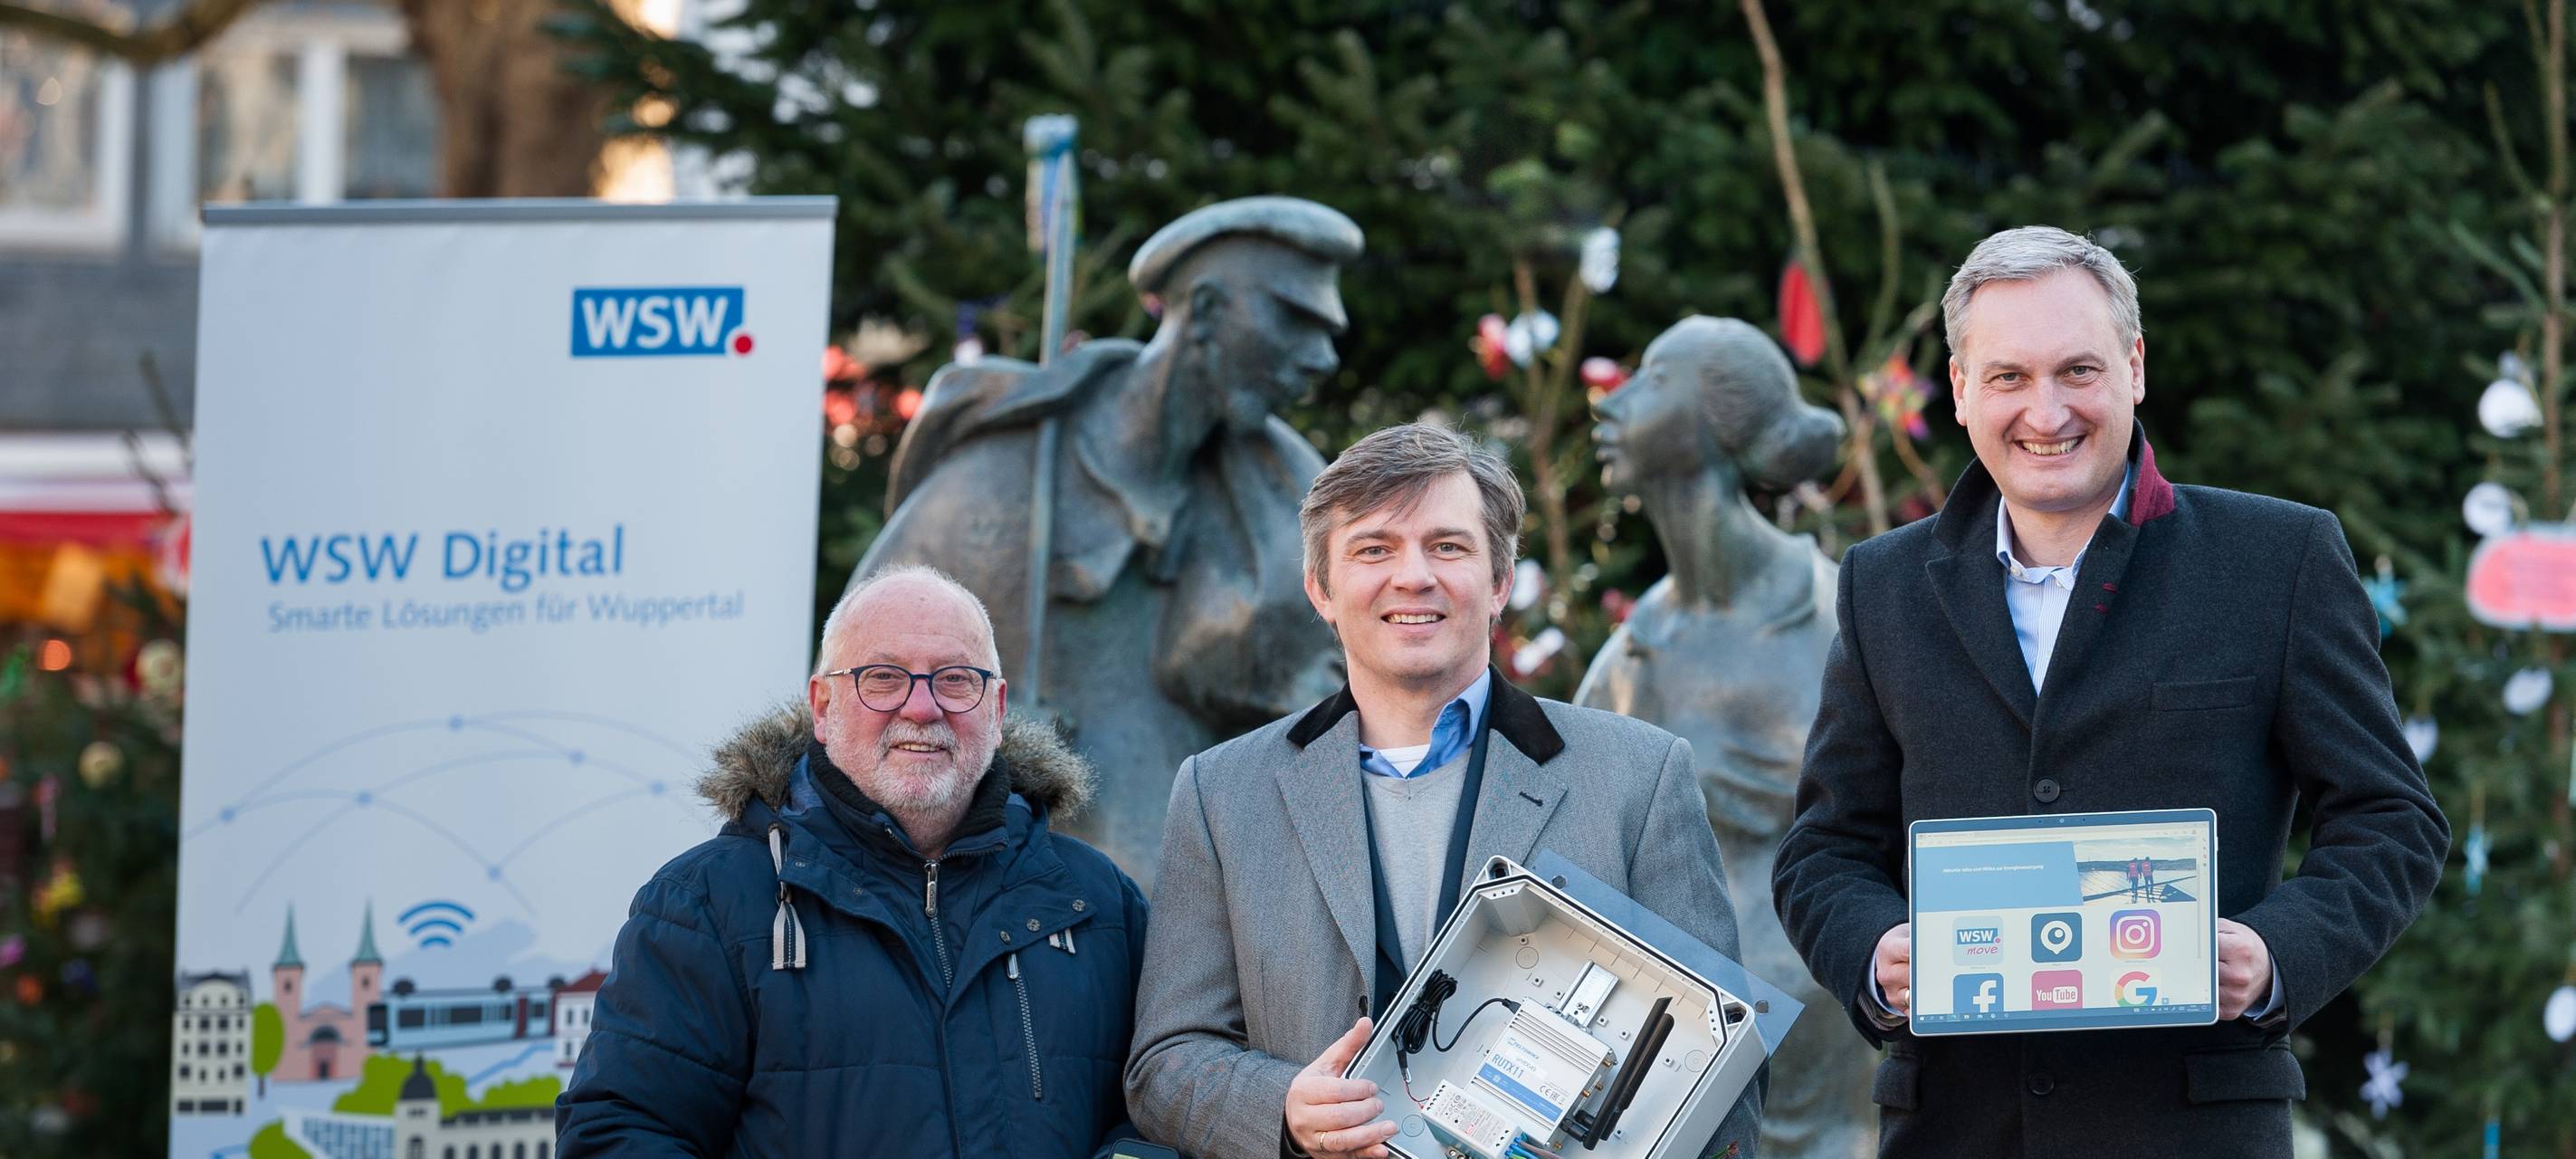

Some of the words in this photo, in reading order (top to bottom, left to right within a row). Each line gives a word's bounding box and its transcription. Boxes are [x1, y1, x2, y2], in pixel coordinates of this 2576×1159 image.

[581, 295, 729, 350] WSW
[261, 532, 419, 585] WSW
[443, 522, 625, 594] Digital
[268, 600, 372, 633] Smarte
[381, 598, 527, 635] Lösungen
[536, 593, 577, 624] für
[588, 590, 745, 629] Wuppertal
[1959, 930, 1994, 943] WSW
[1967, 945, 1999, 956] move
[1491, 1053, 1524, 1079] RUTX11
